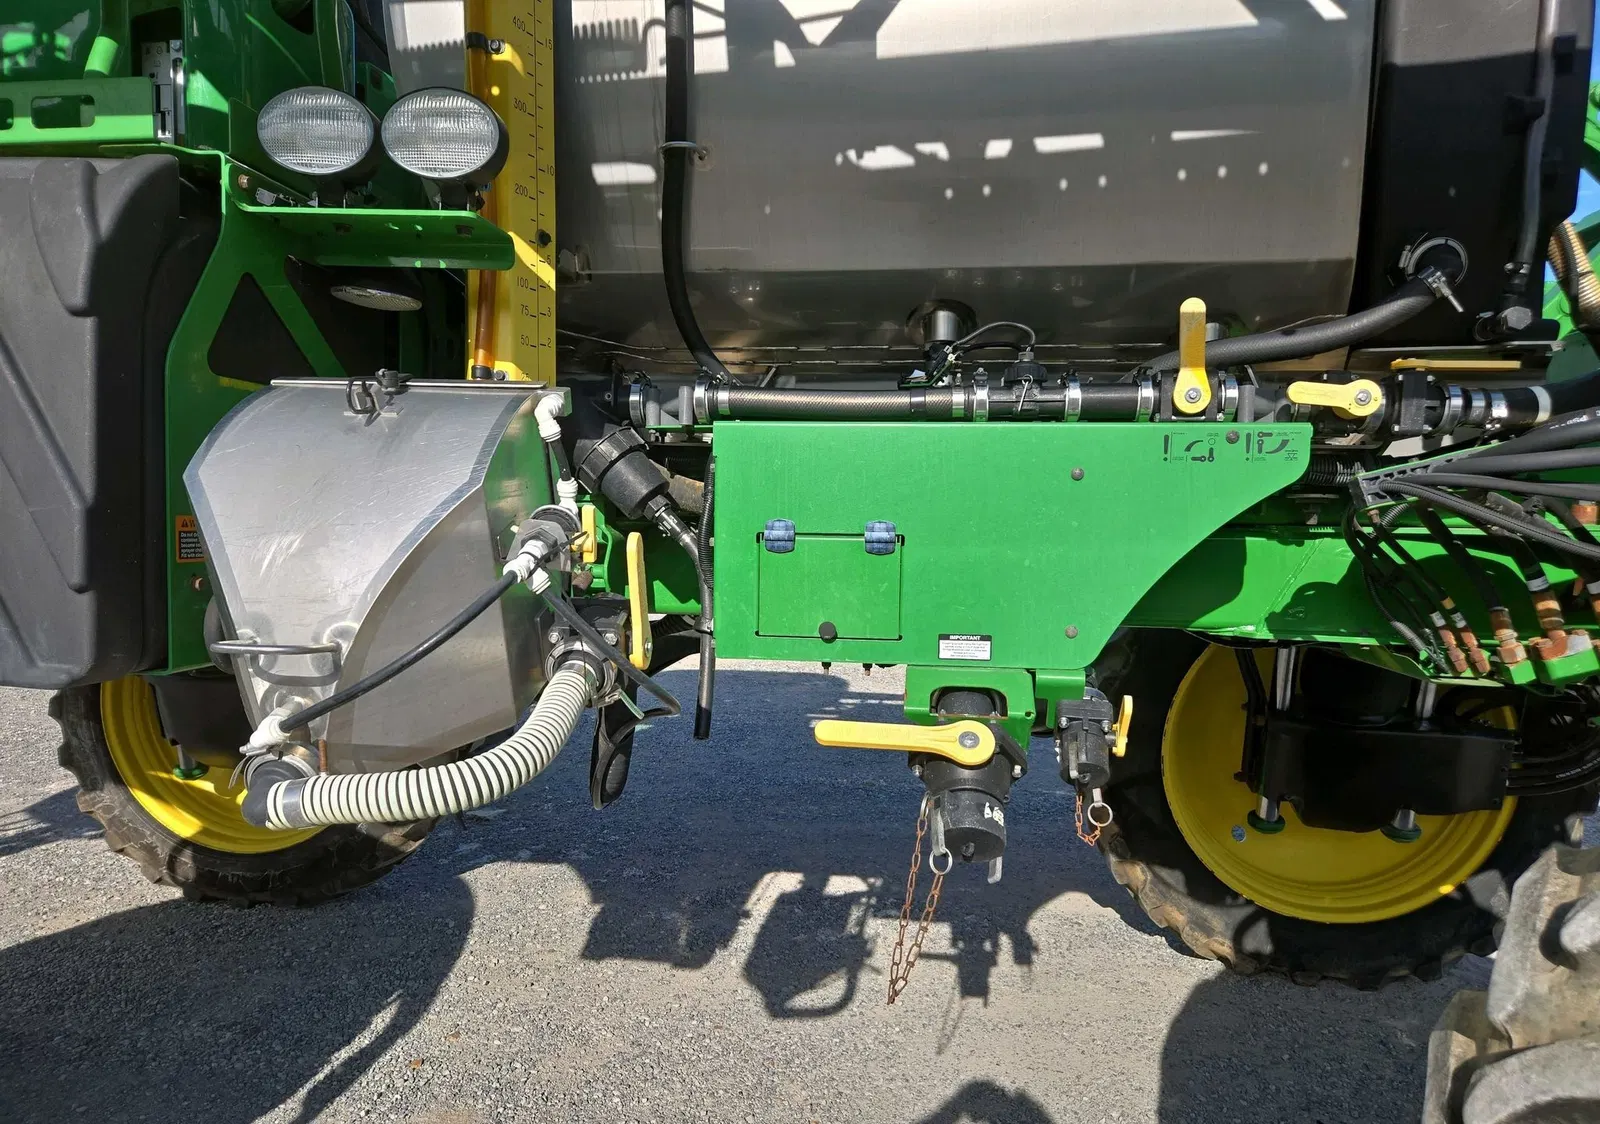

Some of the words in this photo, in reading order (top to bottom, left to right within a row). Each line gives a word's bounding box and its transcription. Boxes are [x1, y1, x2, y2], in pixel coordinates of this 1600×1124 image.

[512, 15, 526, 32] 400
[545, 38, 553, 50] 15
[513, 97, 527, 113] 300
[546, 164, 554, 176] 10
[514, 183, 528, 197] 200
[517, 276, 529, 289] 100
[520, 304, 530, 316] 75
[546, 306, 552, 317] 3
[520, 334, 530, 346] 50
[546, 337, 552, 348] 2
